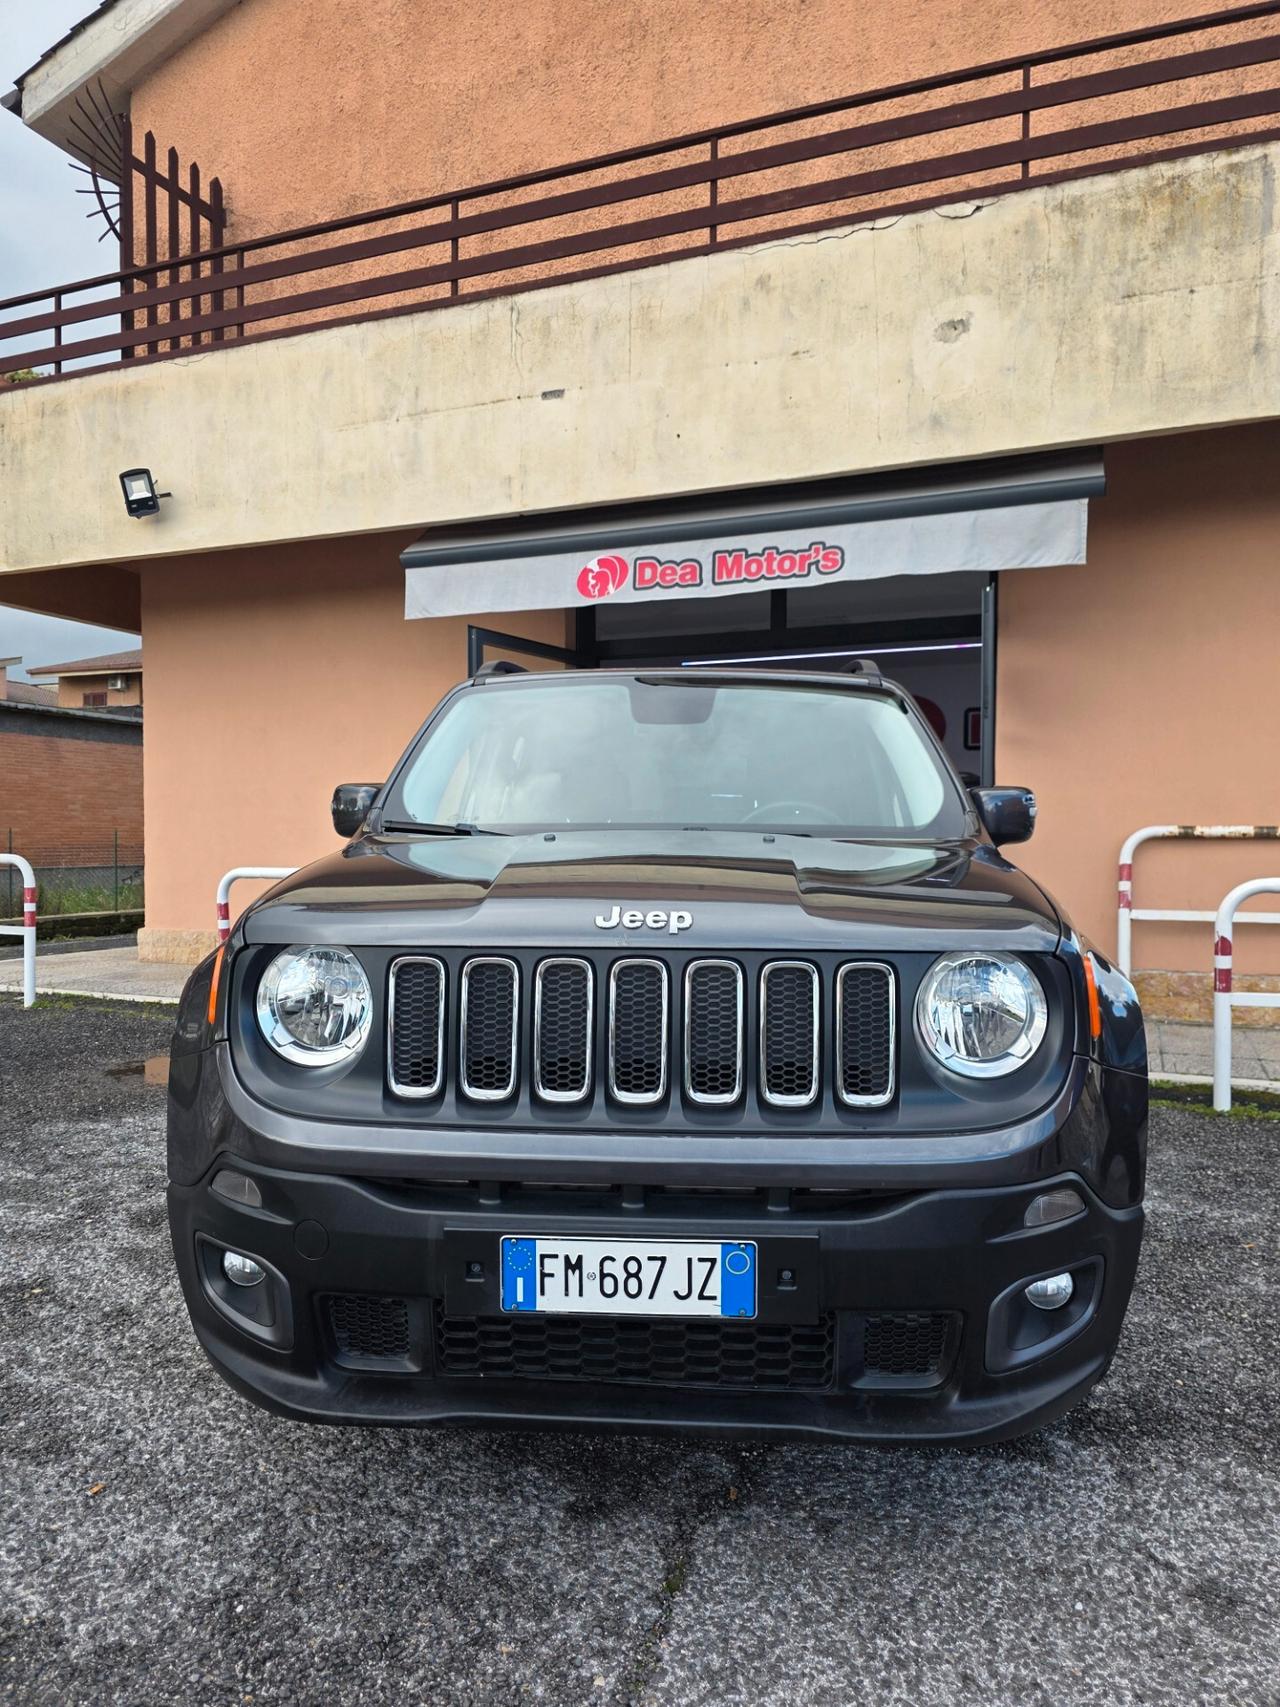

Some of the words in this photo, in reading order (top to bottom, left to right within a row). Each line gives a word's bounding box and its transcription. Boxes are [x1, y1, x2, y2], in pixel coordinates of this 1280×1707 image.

[635, 557, 702, 590] Dea
[713, 542, 844, 583] Motor's
[595, 905, 693, 935] Jeep
